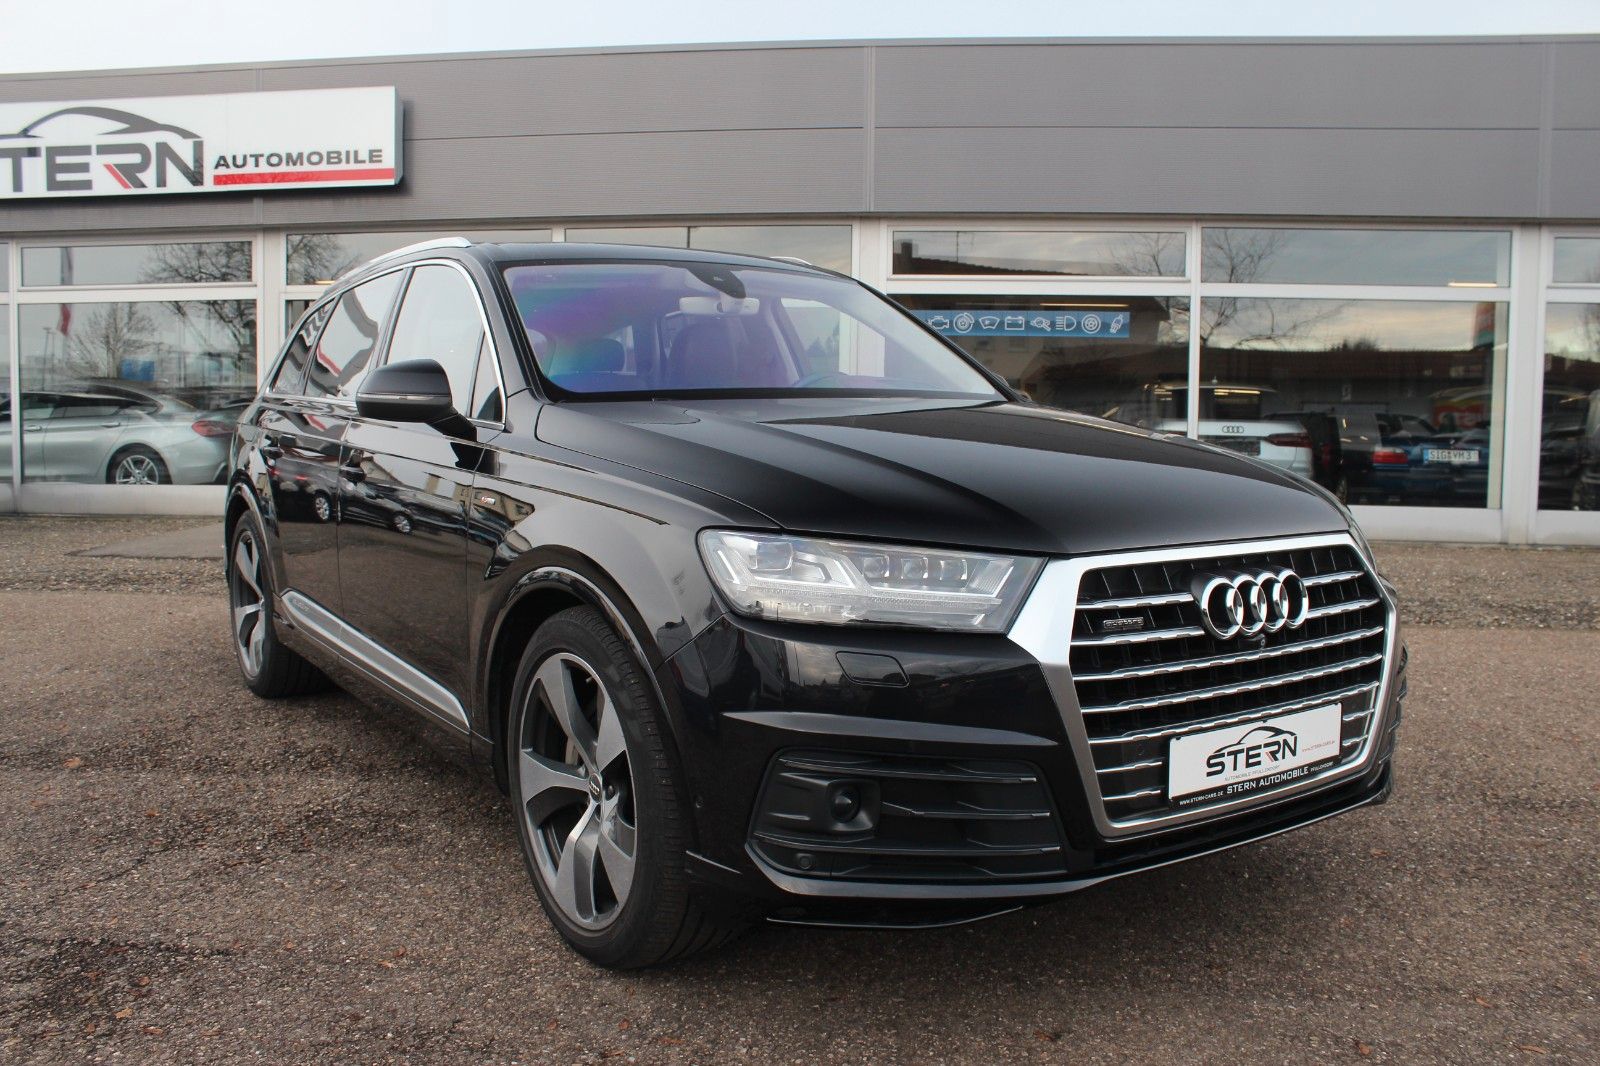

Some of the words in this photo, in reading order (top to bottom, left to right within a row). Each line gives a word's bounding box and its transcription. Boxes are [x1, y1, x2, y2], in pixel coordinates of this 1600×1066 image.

[214, 148, 384, 170] AUTOMOBILE
[1206, 735, 1298, 778] STERN
[1226, 780, 1257, 794] STERN
[1258, 766, 1309, 787] AUTOMOBILE
